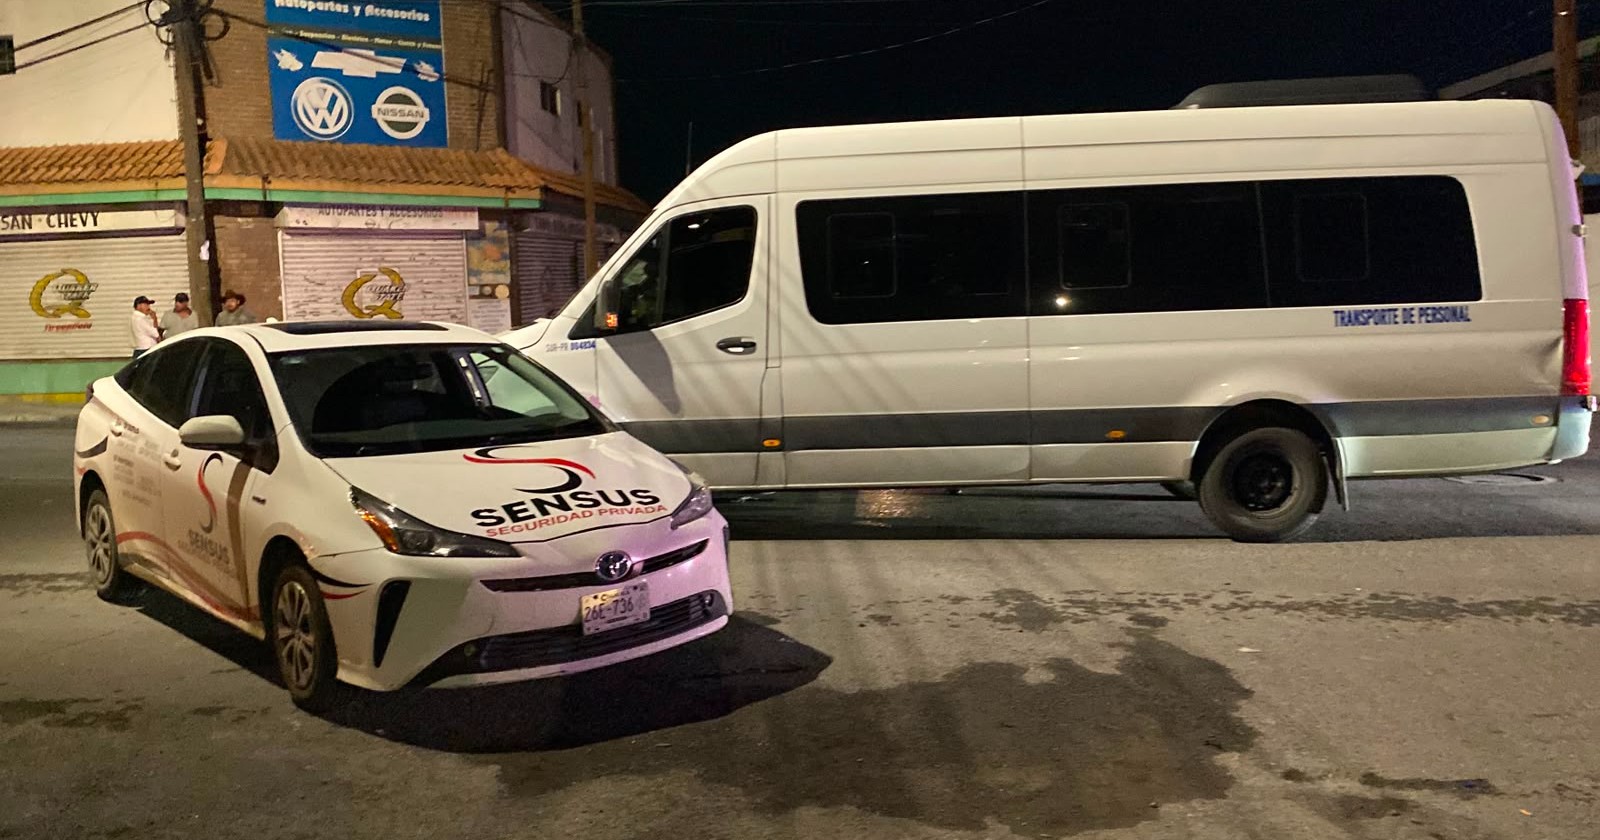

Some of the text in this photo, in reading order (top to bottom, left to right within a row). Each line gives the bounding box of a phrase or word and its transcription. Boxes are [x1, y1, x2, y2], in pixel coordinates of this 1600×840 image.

[353, 5, 361, 17] y
[365, 4, 430, 21] Accesorios
[376, 107, 425, 119] NISSAN
[46, 212, 100, 228] CHEVY
[1333, 306, 1472, 327] TRANSPORTE DE PERSONAL
[471, 489, 660, 526] SENSUS
[486, 504, 668, 537] SEGURIDAD PRIVADA
